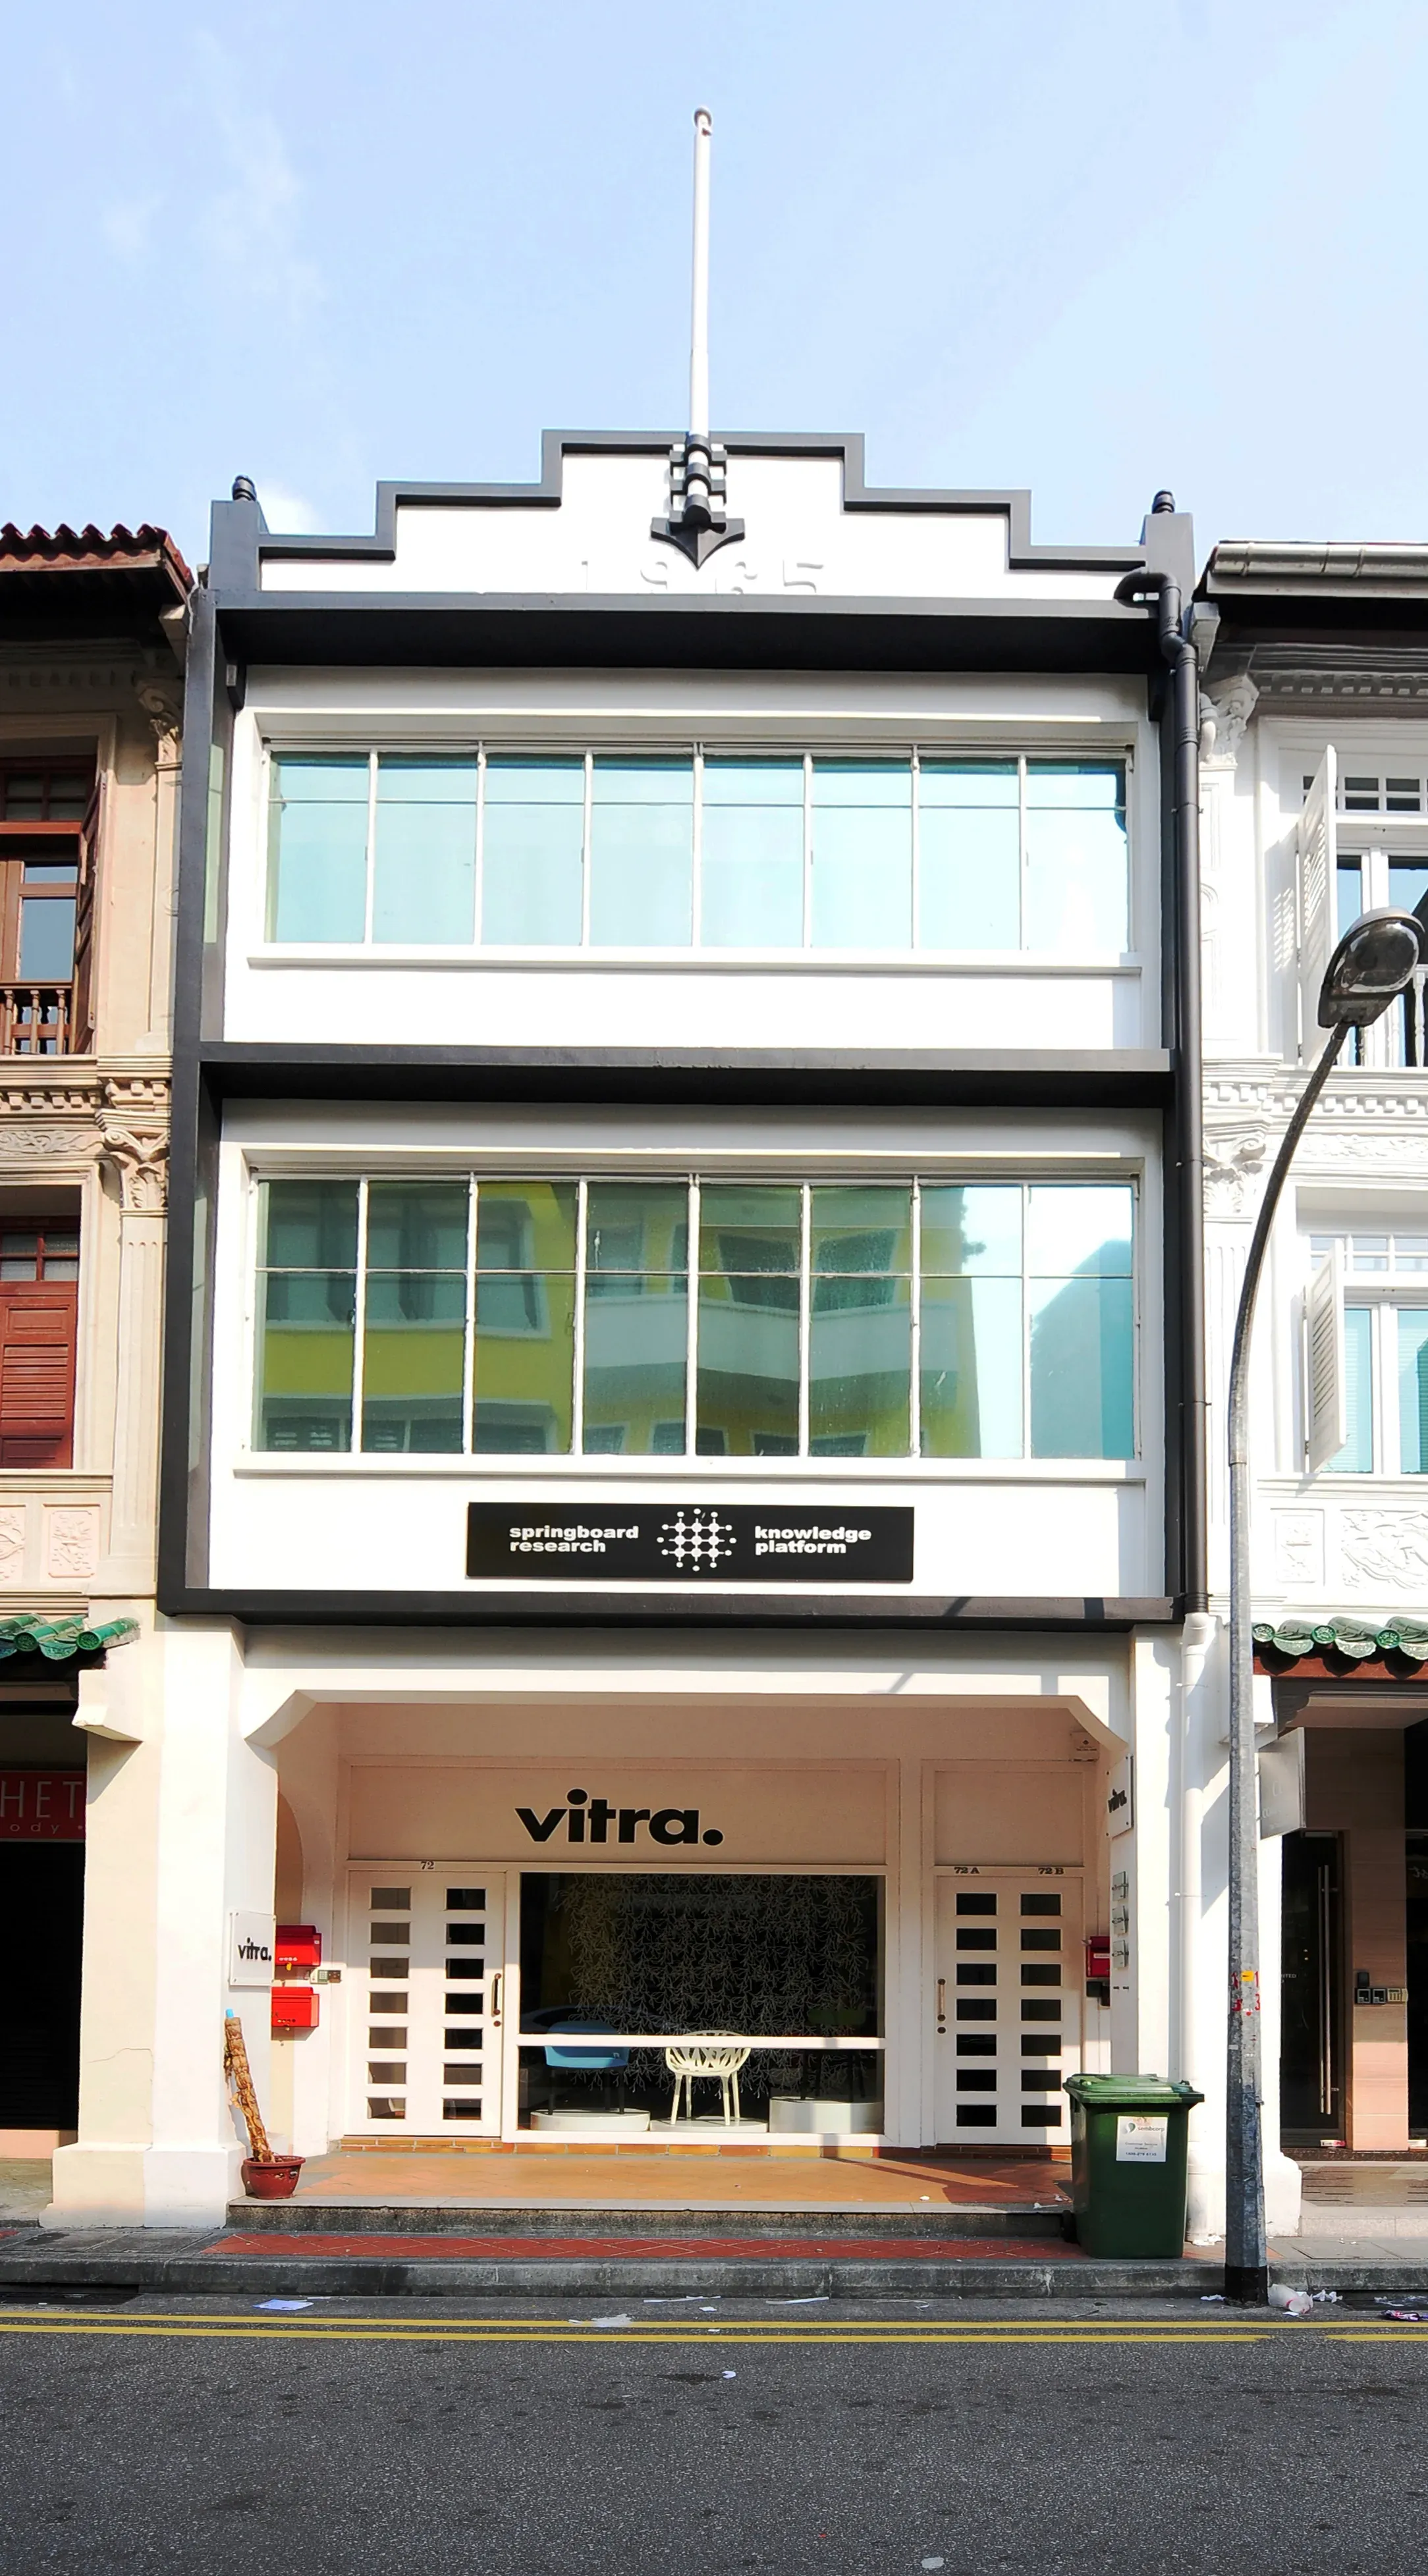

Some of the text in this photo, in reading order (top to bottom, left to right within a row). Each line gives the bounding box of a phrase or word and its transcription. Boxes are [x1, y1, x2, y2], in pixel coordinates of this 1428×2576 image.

[509, 1525, 639, 1541] springboard
[755, 1526, 871, 1543] knowledge
[510, 1540, 606, 1552] research
[755, 1540, 846, 1555] platform
[0, 1781, 83, 1818] HET
[514, 1788, 723, 1846] vitra.
[420, 1860, 435, 1869] 72
[238, 1937, 272, 1961] vitra.
